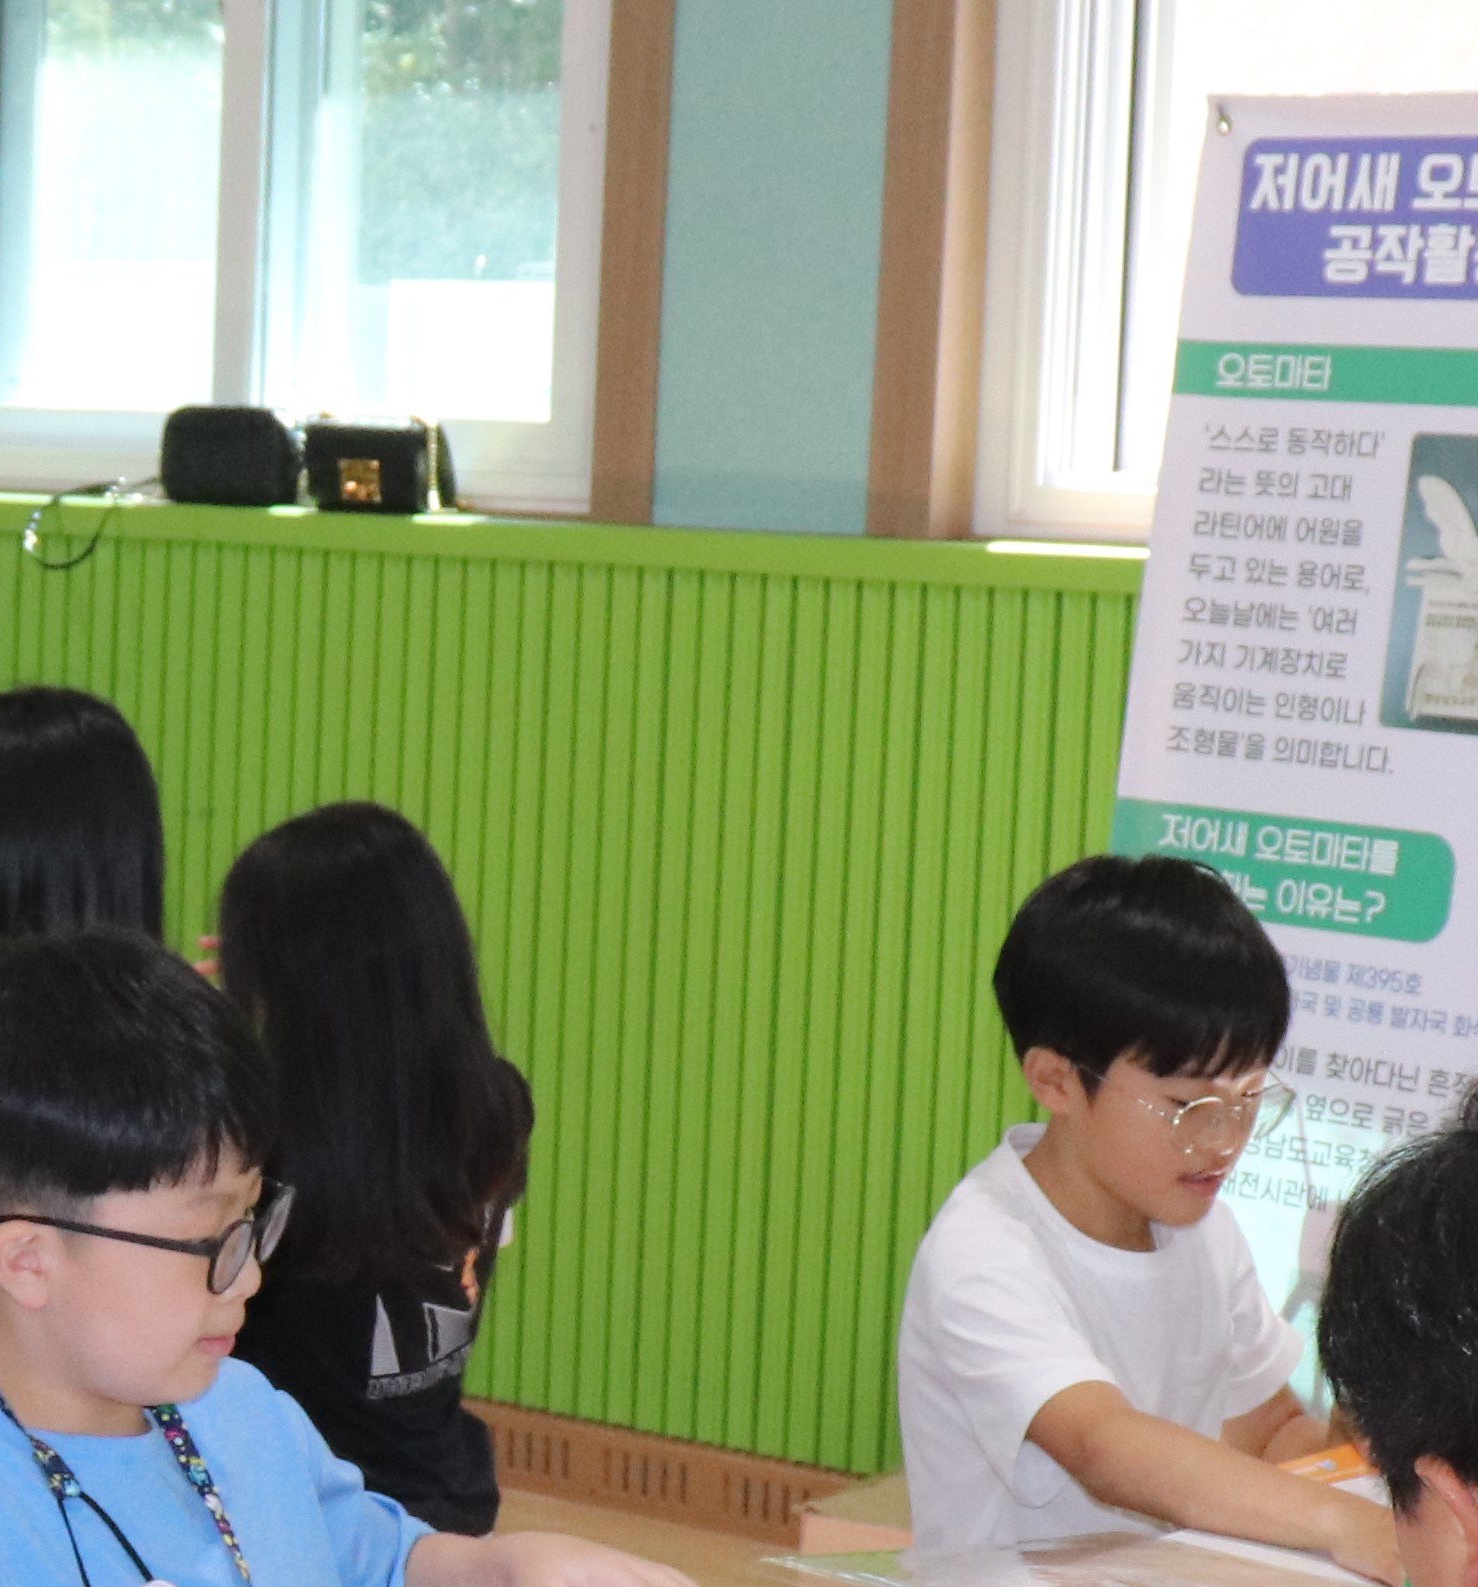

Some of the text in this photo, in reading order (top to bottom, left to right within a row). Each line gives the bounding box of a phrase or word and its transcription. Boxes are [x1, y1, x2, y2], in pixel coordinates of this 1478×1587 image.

[1249, 152, 1401, 213] 저어새
[1215, 352, 1333, 391] 오토마타
[1198, 466, 1353, 502] 라는 뜻의 고대
[1193, 510, 1364, 548] 라틴어에 어원을
[1189, 552, 1236, 582] 두고
[1245, 557, 1288, 586] 있는
[1182, 596, 1300, 632] 오늘날에는
[1177, 639, 1348, 679] 가지 기계장치로
[1172, 681, 1366, 726] 움직이는 인형이나
[1157, 813, 1400, 877] 저어새 오토마타를
[1276, 878, 1387, 925] 이유는?
[1345, 963, 1423, 995] 제395호
[1325, 1051, 1420, 1094] 찾아다닌
[1304, 1093, 1375, 1132] 옆으로
